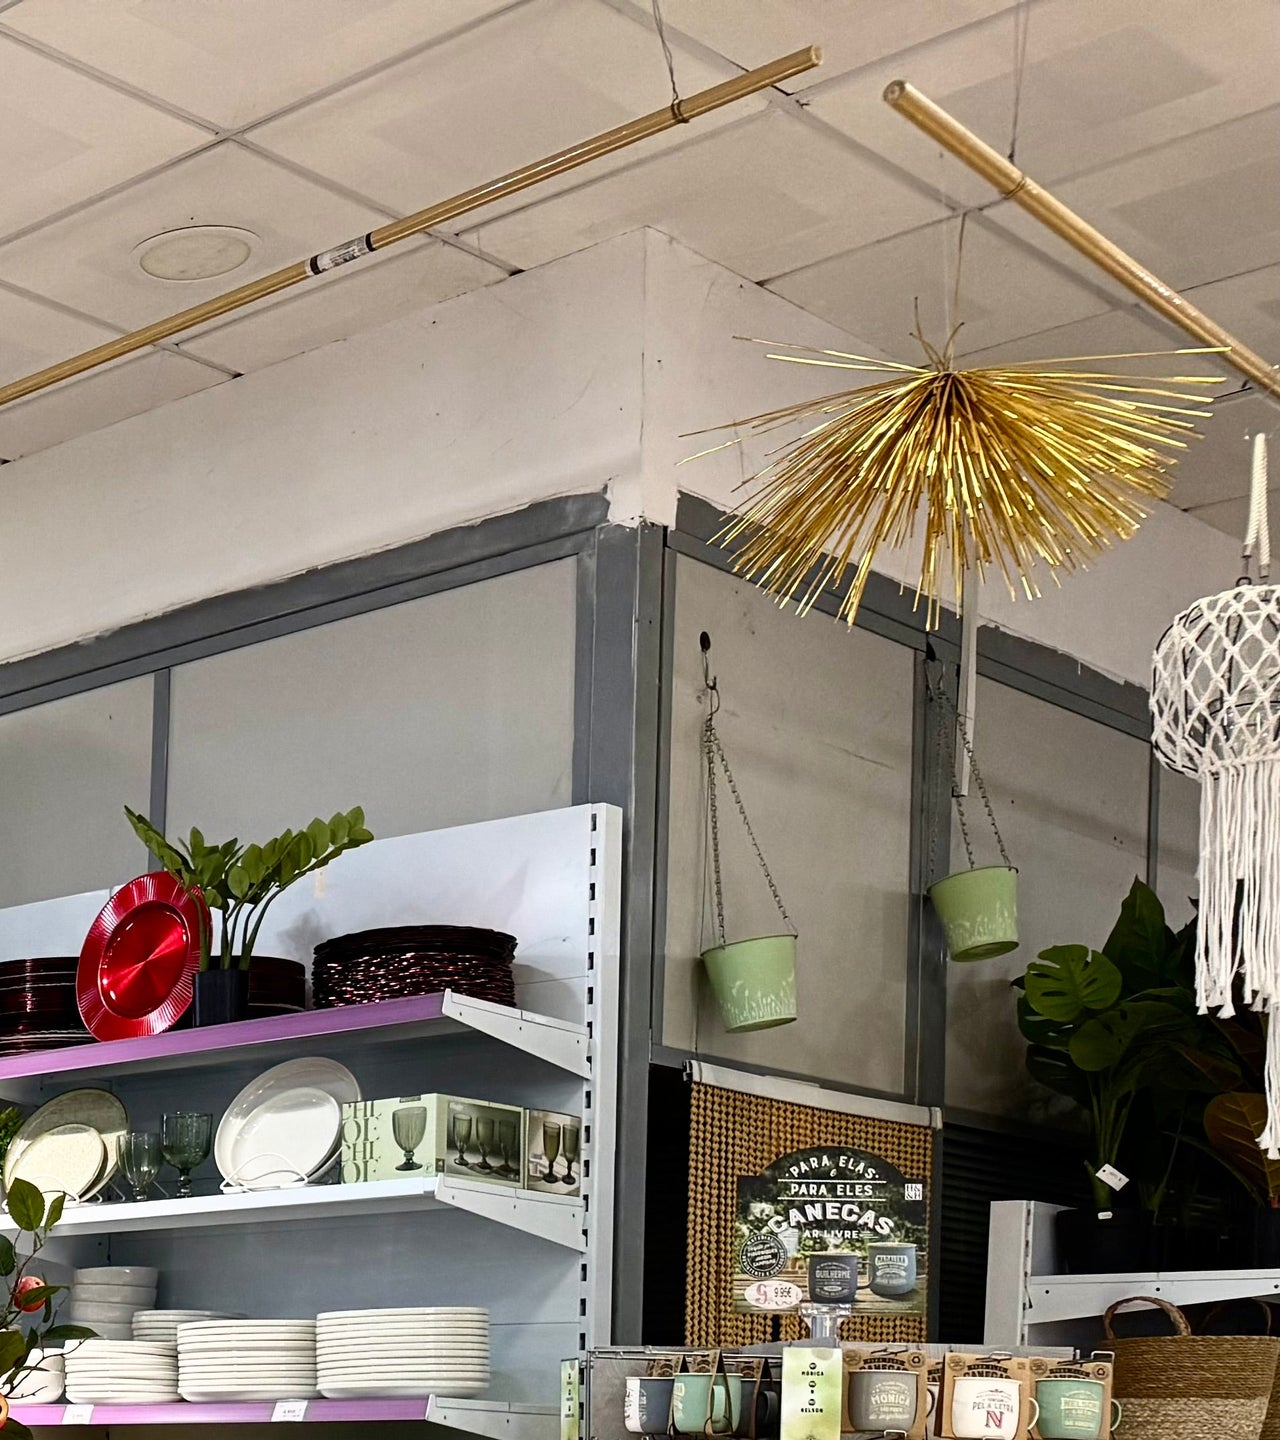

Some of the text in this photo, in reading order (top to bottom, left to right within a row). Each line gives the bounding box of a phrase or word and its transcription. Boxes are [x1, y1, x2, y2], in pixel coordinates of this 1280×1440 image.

[789, 1154, 877, 1179] PARA ELAS
[790, 1183, 874, 1196] PARA ELES
[767, 1202, 895, 1235] CANECAS
[823, 1229, 859, 1240] LIVRE
[815, 1269, 851, 1280] GUILHERME
[972, 1401, 992, 1412] PELA
[984, 1410, 1004, 1430] N
